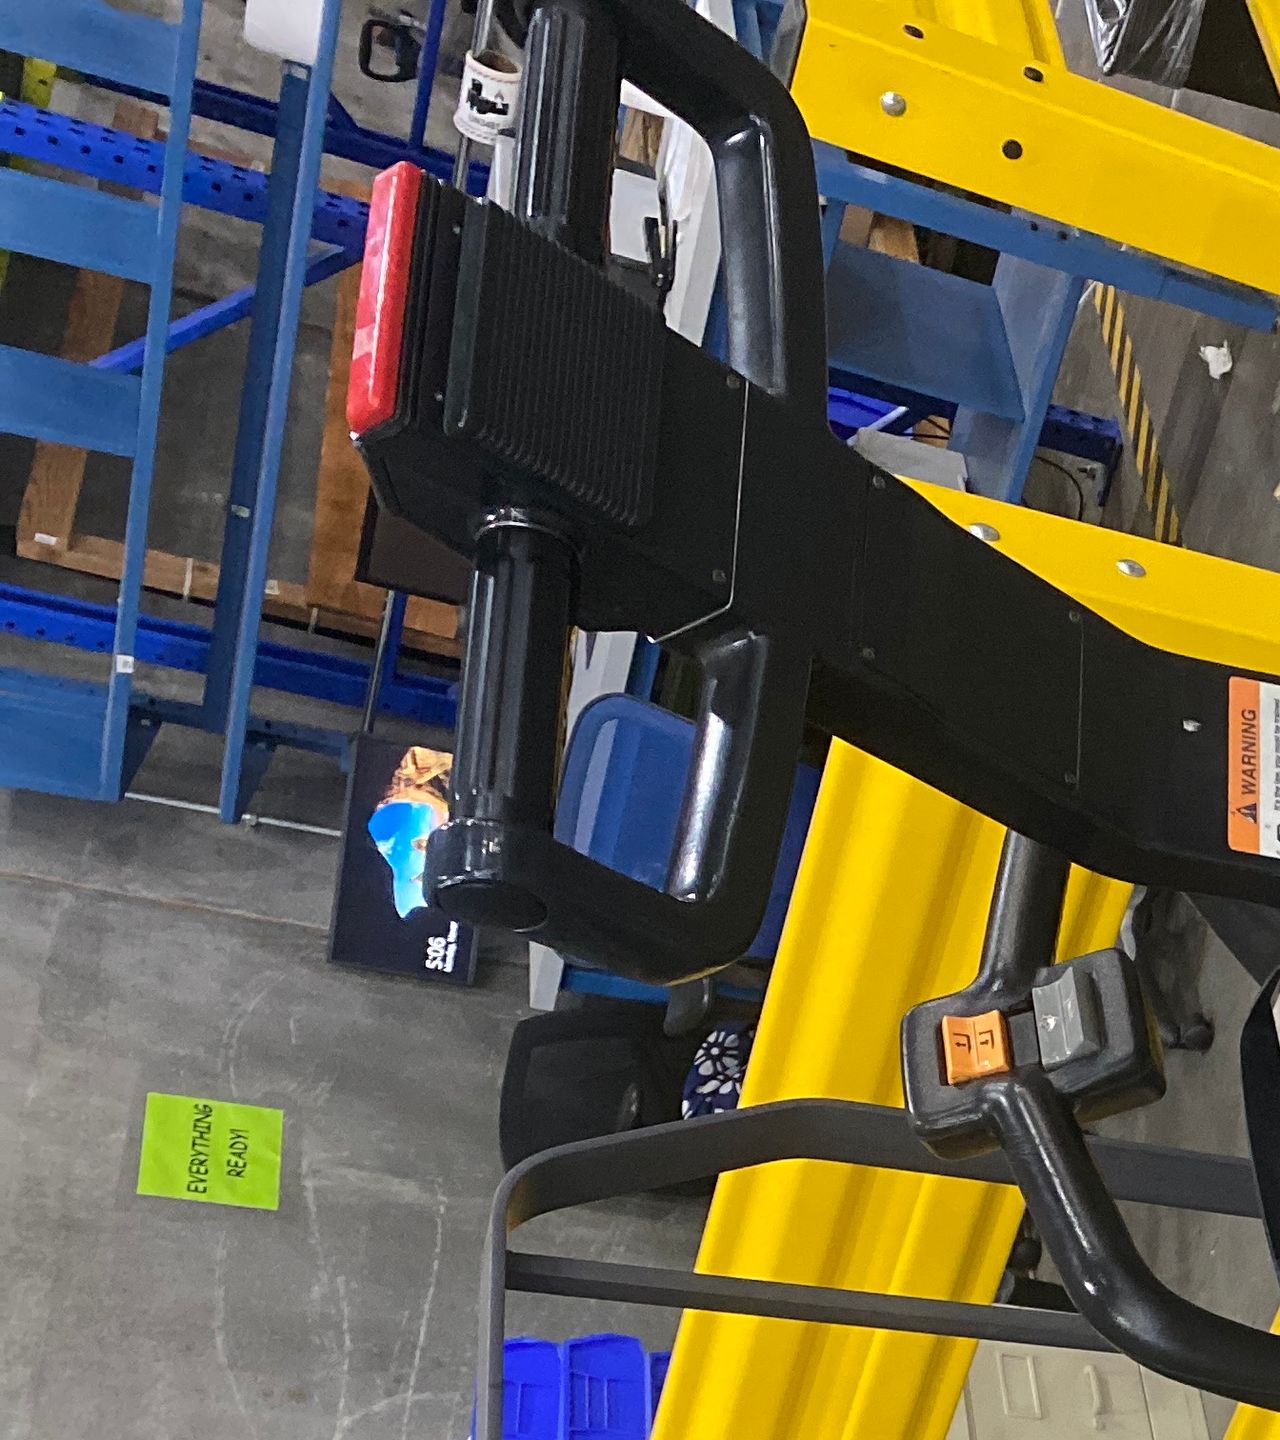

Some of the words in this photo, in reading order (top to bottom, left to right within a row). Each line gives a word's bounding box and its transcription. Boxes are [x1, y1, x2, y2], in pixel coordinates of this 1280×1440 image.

[1241, 709, 1257, 796] WARNING
[425, 937, 446, 970] 5:06
[186, 1104, 213, 1194] EVERYTHING
[226, 1129, 250, 1178] READY!
